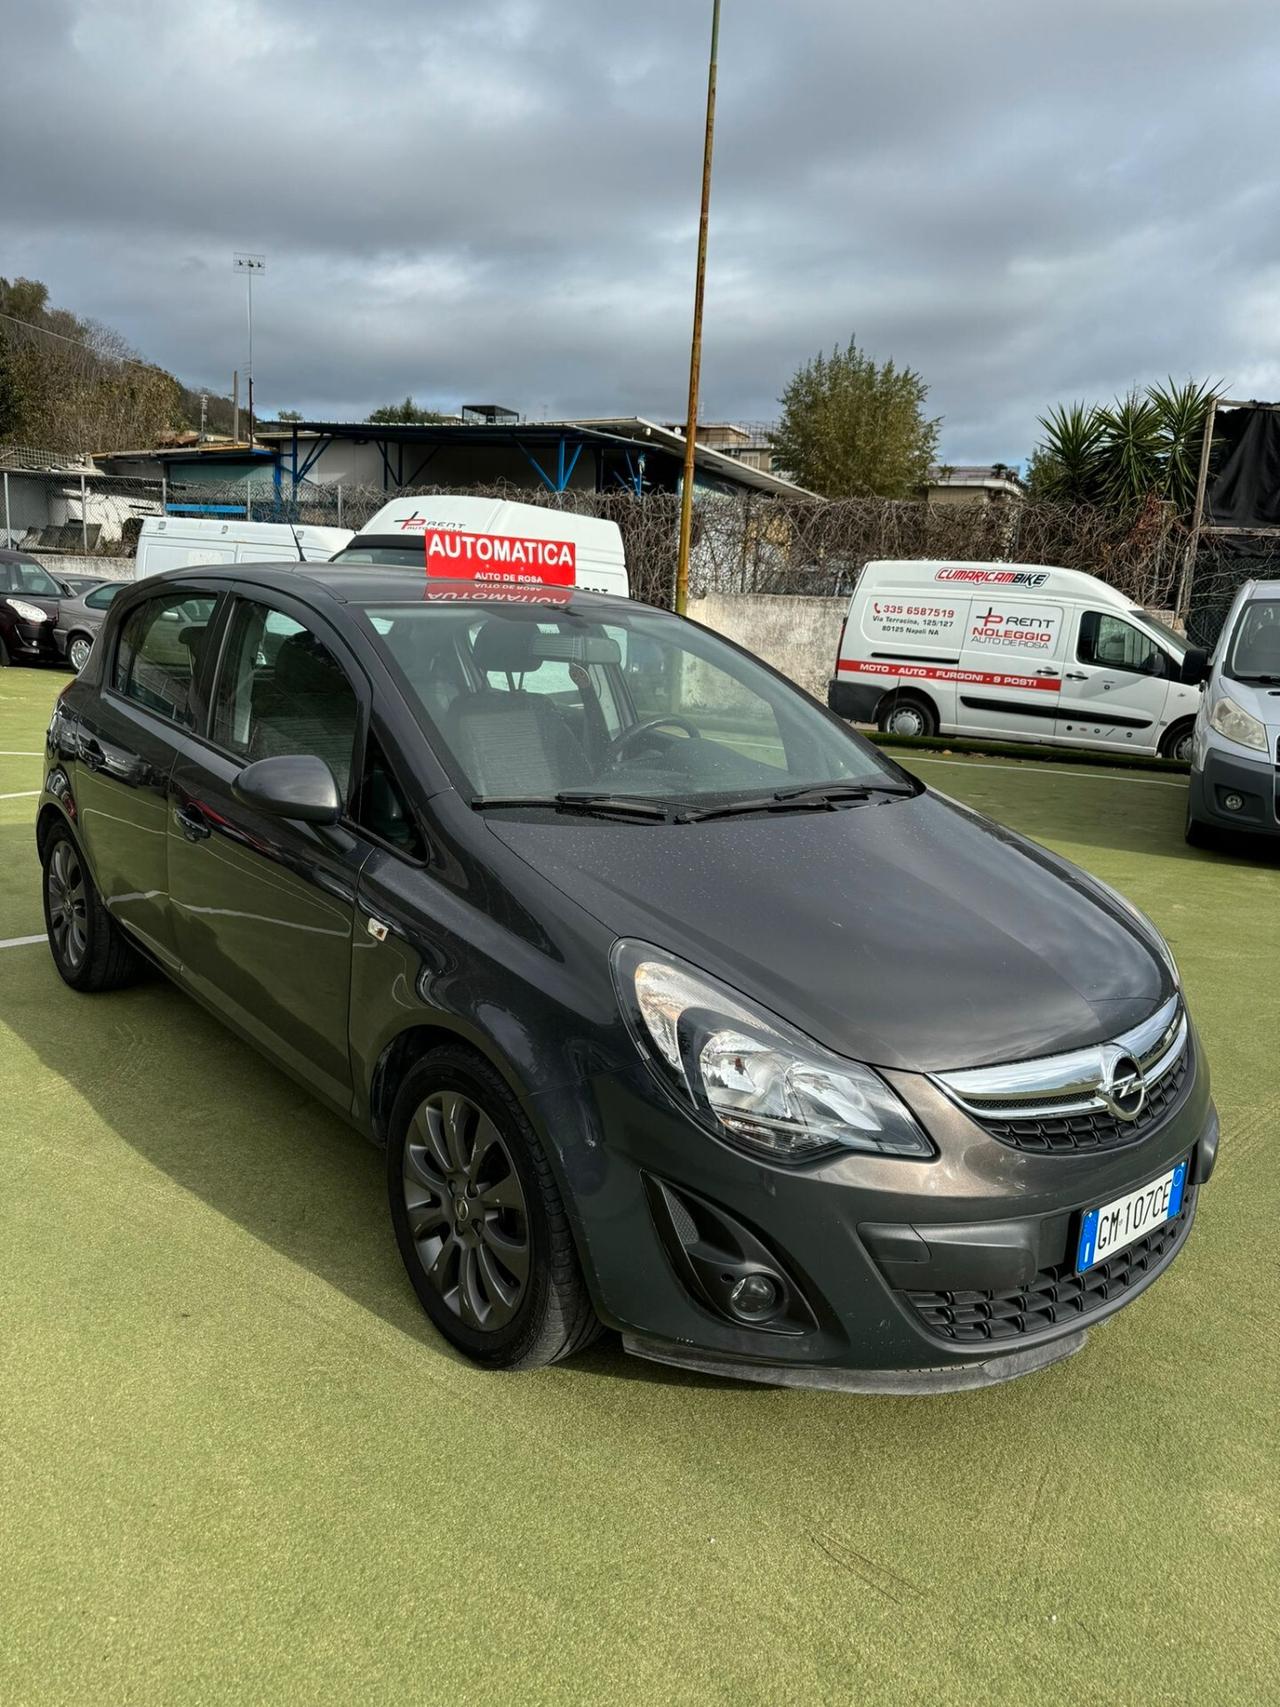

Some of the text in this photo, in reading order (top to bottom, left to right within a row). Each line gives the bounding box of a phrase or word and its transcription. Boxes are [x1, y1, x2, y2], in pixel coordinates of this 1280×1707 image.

[428, 533, 574, 566] AUTOMATICA
[474, 571, 543, 583] AUTO DE ROSA
[883, 604, 955, 618] 335 6587519
[886, 616, 920, 626] Terracina,
[922, 619, 954, 628] 125/127
[881, 625, 904, 633] 80125
[905, 627, 927, 635] Napoli
[972, 627, 1052, 642] NOLEGGIO
[971, 635, 1049, 649] AUTO DE ROSA
[860, 662, 890, 673] MOTO
[898, 666, 927, 677] AUTO
[935, 670, 984, 682] FURGONI
[993, 675, 1001, 684] 9
[1003, 677, 1038, 687] POSTI
